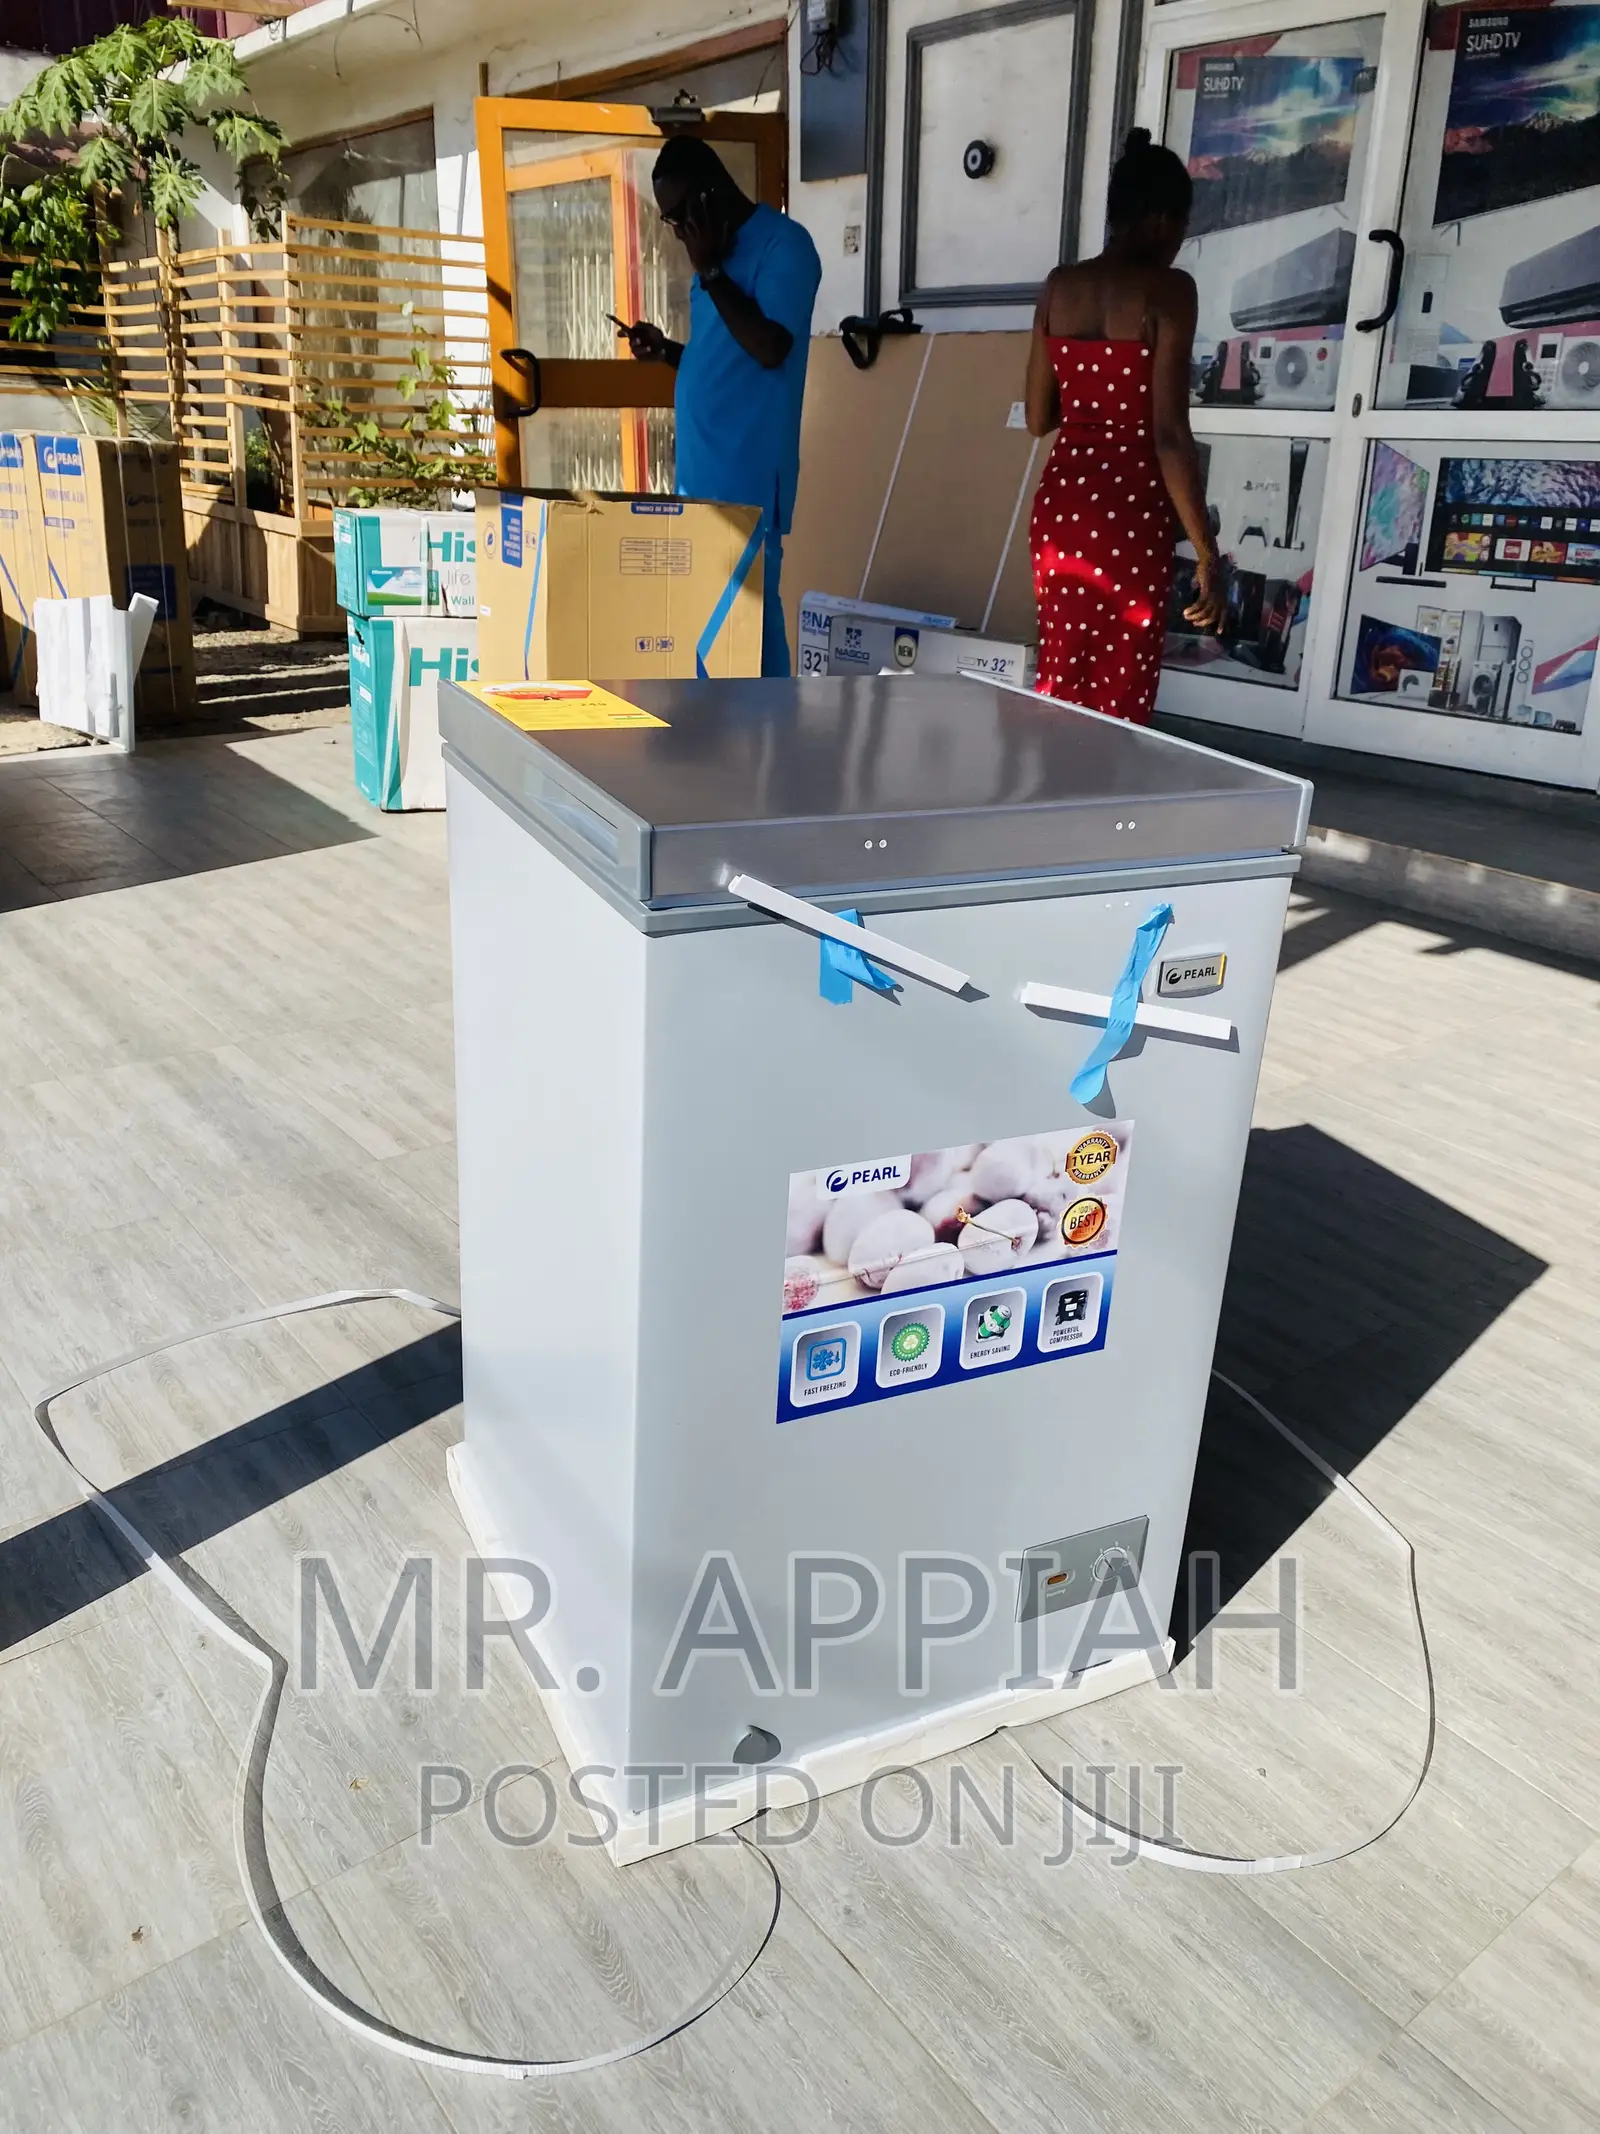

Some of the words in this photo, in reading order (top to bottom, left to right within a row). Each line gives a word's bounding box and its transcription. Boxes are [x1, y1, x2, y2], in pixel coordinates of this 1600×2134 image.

[835, 647, 870, 660] NASCO
[898, 645, 913, 657] NEW
[977, 658, 988, 667] TV
[1184, 967, 1217, 980] PEARL
[1076, 1138, 1109, 1152] WARRANTY
[1072, 1156, 1078, 1167] 1
[1080, 1151, 1111, 1166] YEAR
[852, 1166, 901, 1185] PEARL
[1070, 1212, 1099, 1230] BEST
[1049, 1332, 1083, 1345] COMPRESSOR
[1053, 1326, 1080, 1337] POWERFUL
[970, 1350, 990, 1359] ENERGY
[992, 1345, 1011, 1355] SAVING
[890, 1363, 929, 1377] ECO-FRIENDLY
[804, 1387, 819, 1397] FAST
[820, 1381, 847, 1393] FREEZING
